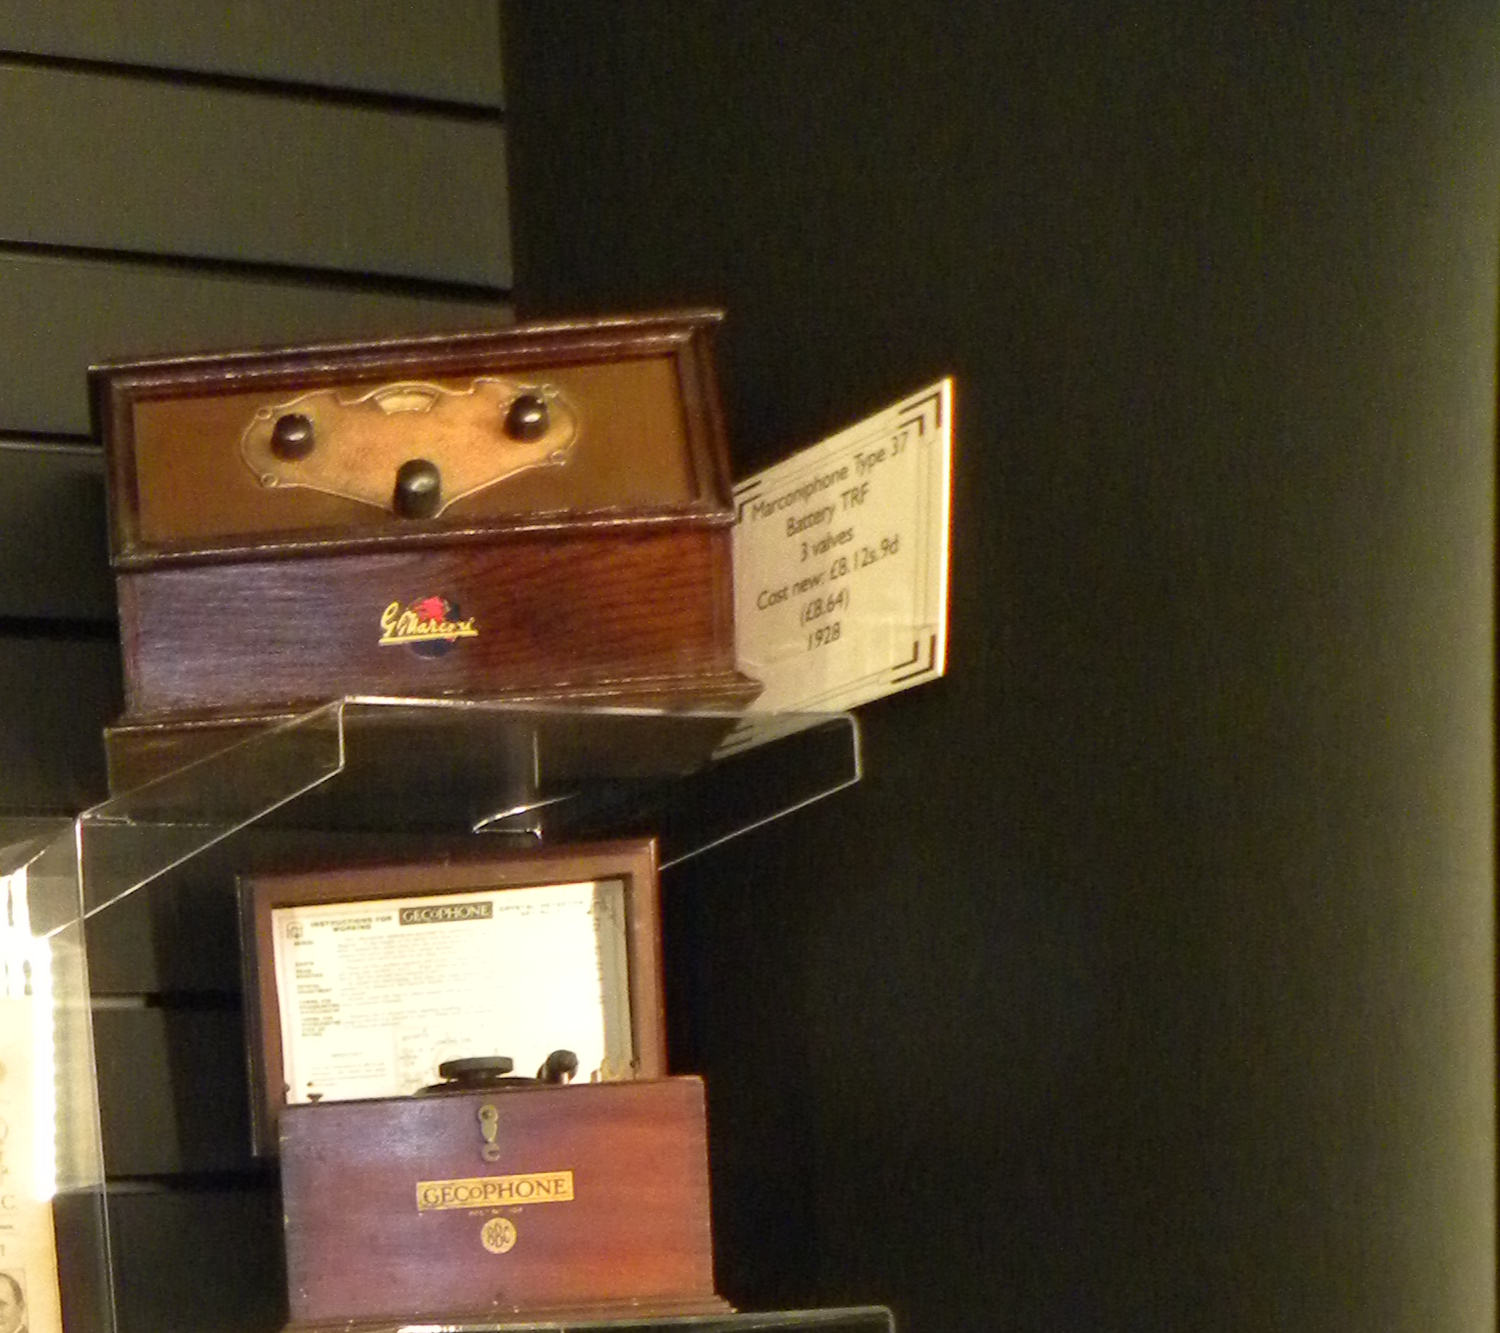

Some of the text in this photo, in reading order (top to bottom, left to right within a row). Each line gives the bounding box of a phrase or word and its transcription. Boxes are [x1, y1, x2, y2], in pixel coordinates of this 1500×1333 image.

[751, 431, 910, 522] Marconiphone Type 37
[786, 482, 870, 538] Battery TRF
[800, 527, 855, 563] 3 valves
[756, 586, 789, 612] Cost
[807, 622, 841, 651] 1928
